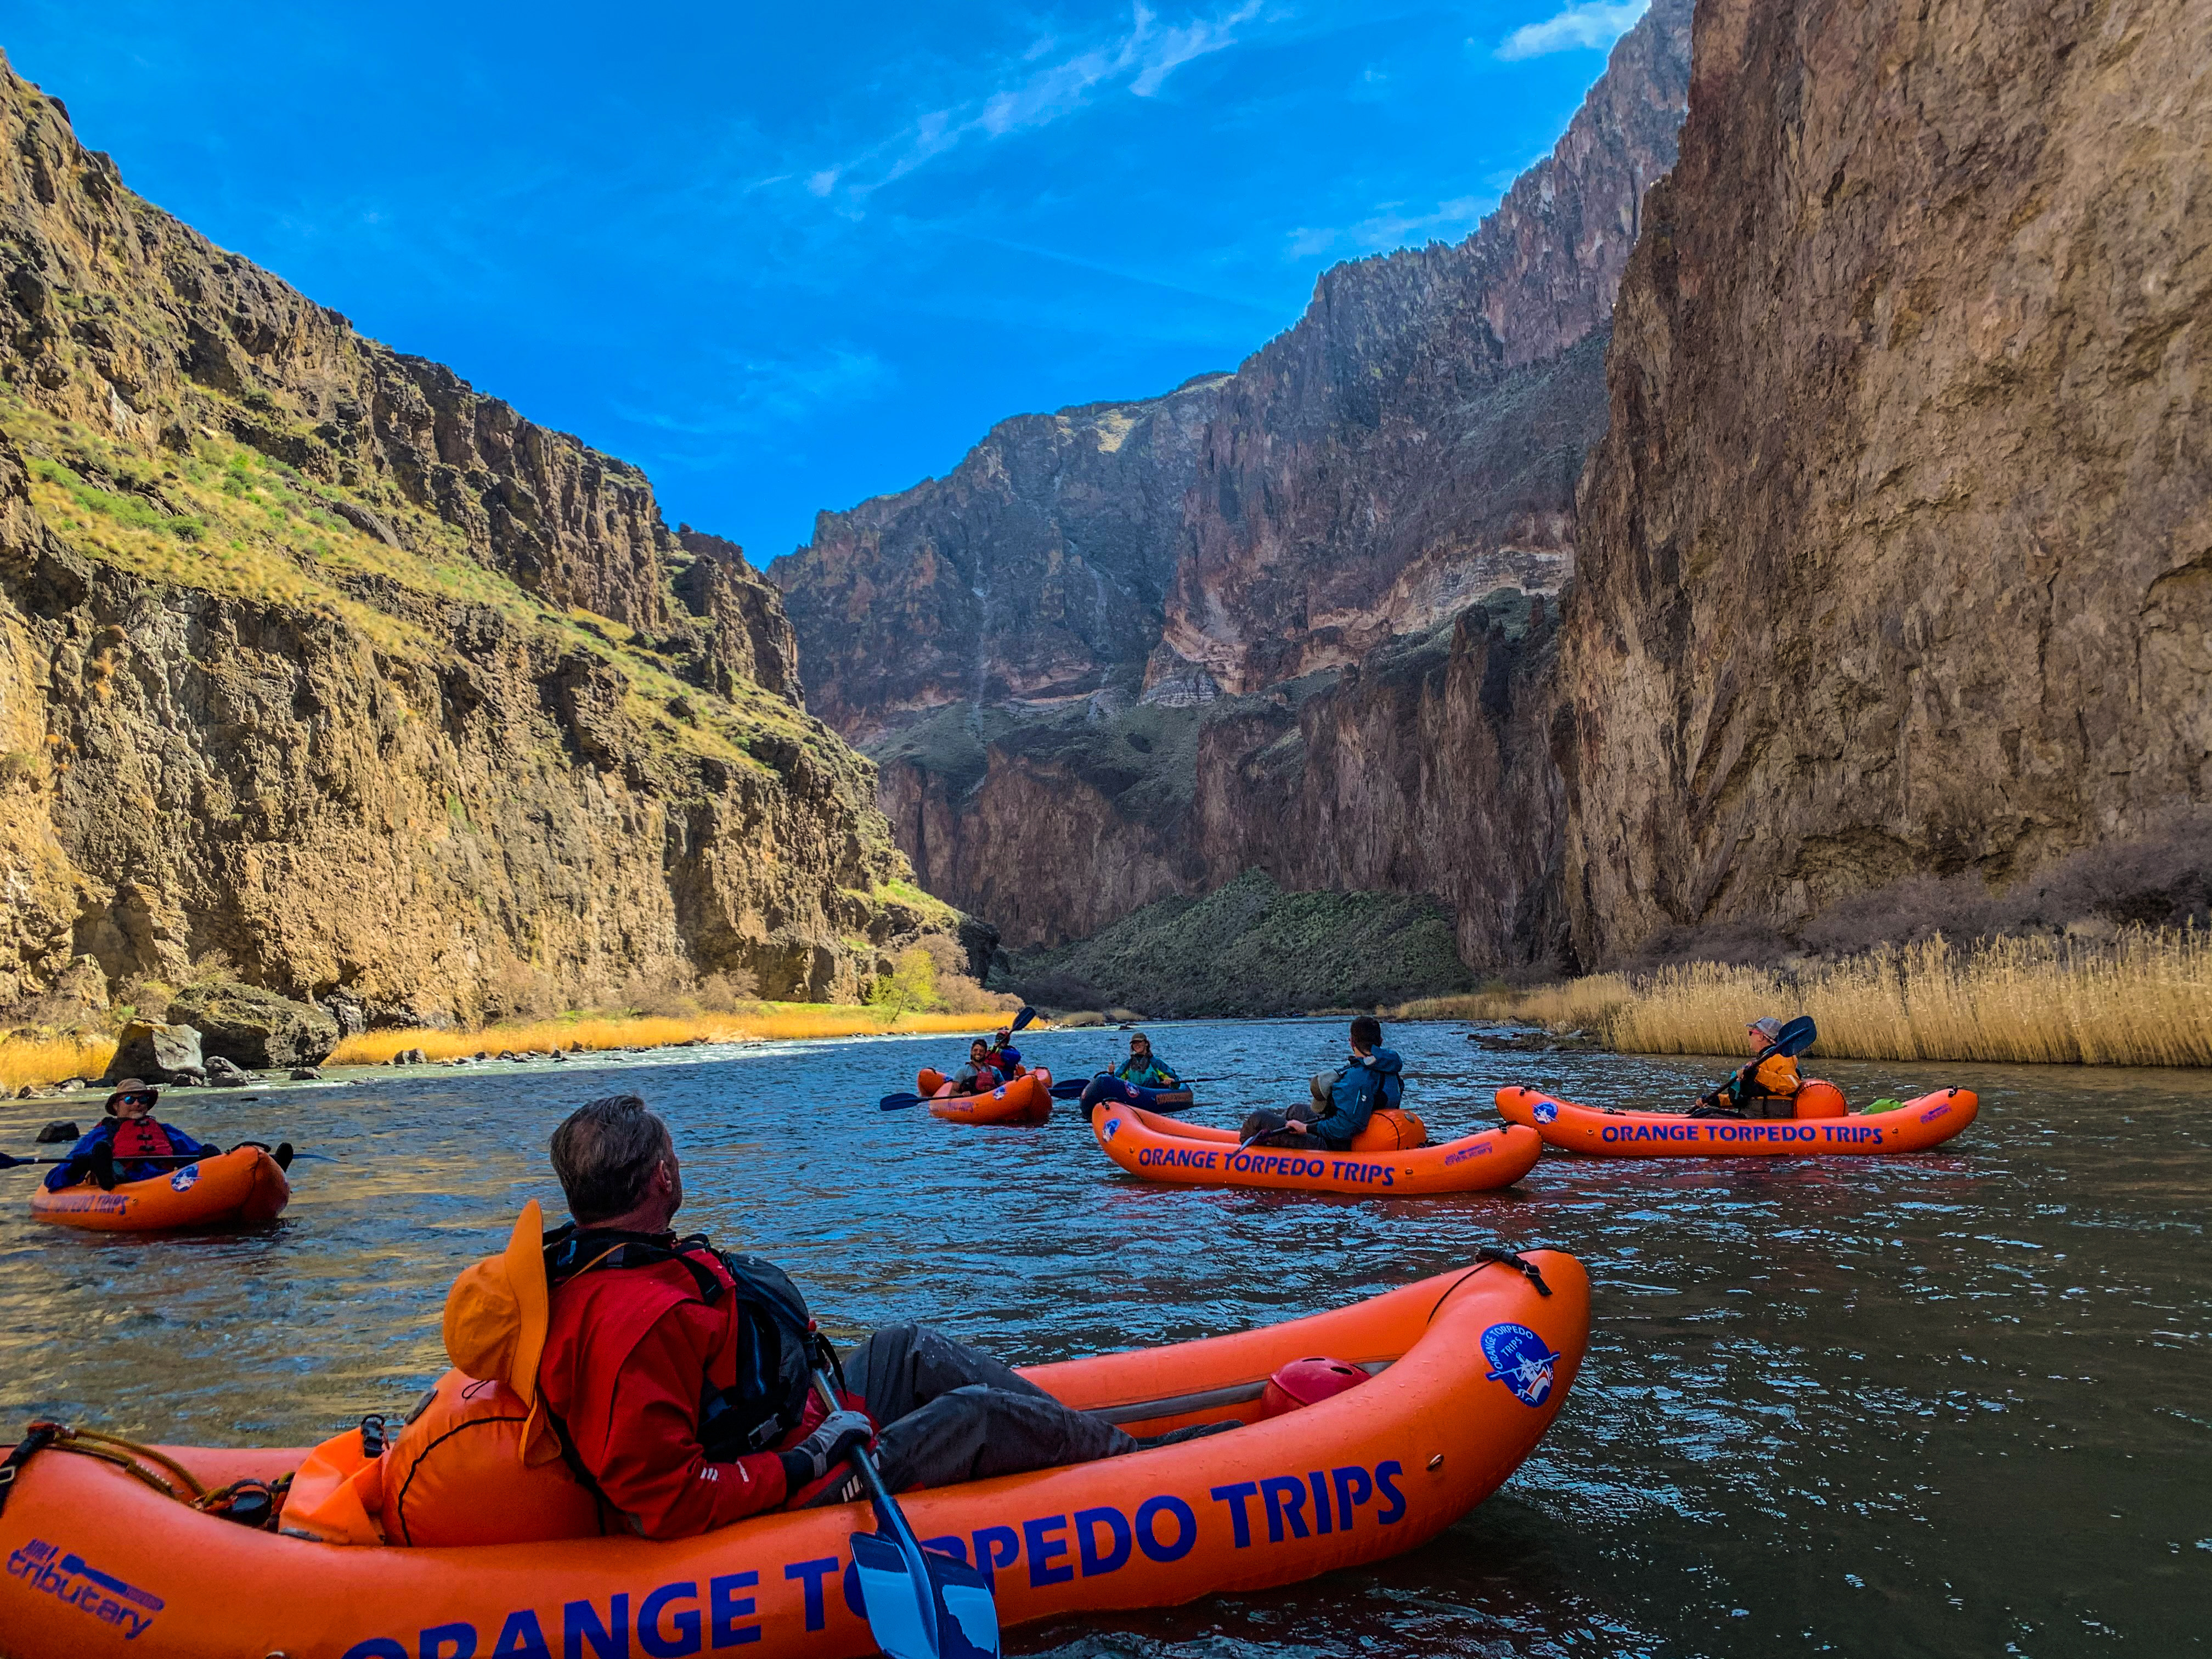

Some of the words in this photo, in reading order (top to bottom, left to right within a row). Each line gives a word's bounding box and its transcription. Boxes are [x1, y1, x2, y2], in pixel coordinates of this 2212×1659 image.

[1601, 1125, 1699, 1142] ORANGE
[1705, 1125, 1816, 1142] TORPEDO
[1821, 1126, 1883, 1144] TRIPS
[1139, 1148, 1219, 1169] ORANGE
[1224, 1152, 1325, 1178] TORPEDO
[1331, 1160, 1395, 1186] TRIPS
[1489, 1325, 1533, 1340] TORPEDO
[1500, 1336, 1522, 1357] TRIPS
[1485, 1335, 1503, 1370] ORANGE
[784, 1495, 1197, 1632] TPEDO
[1210, 1460, 1407, 1549] TRIPS
[6, 1549, 153, 1640] tributary
